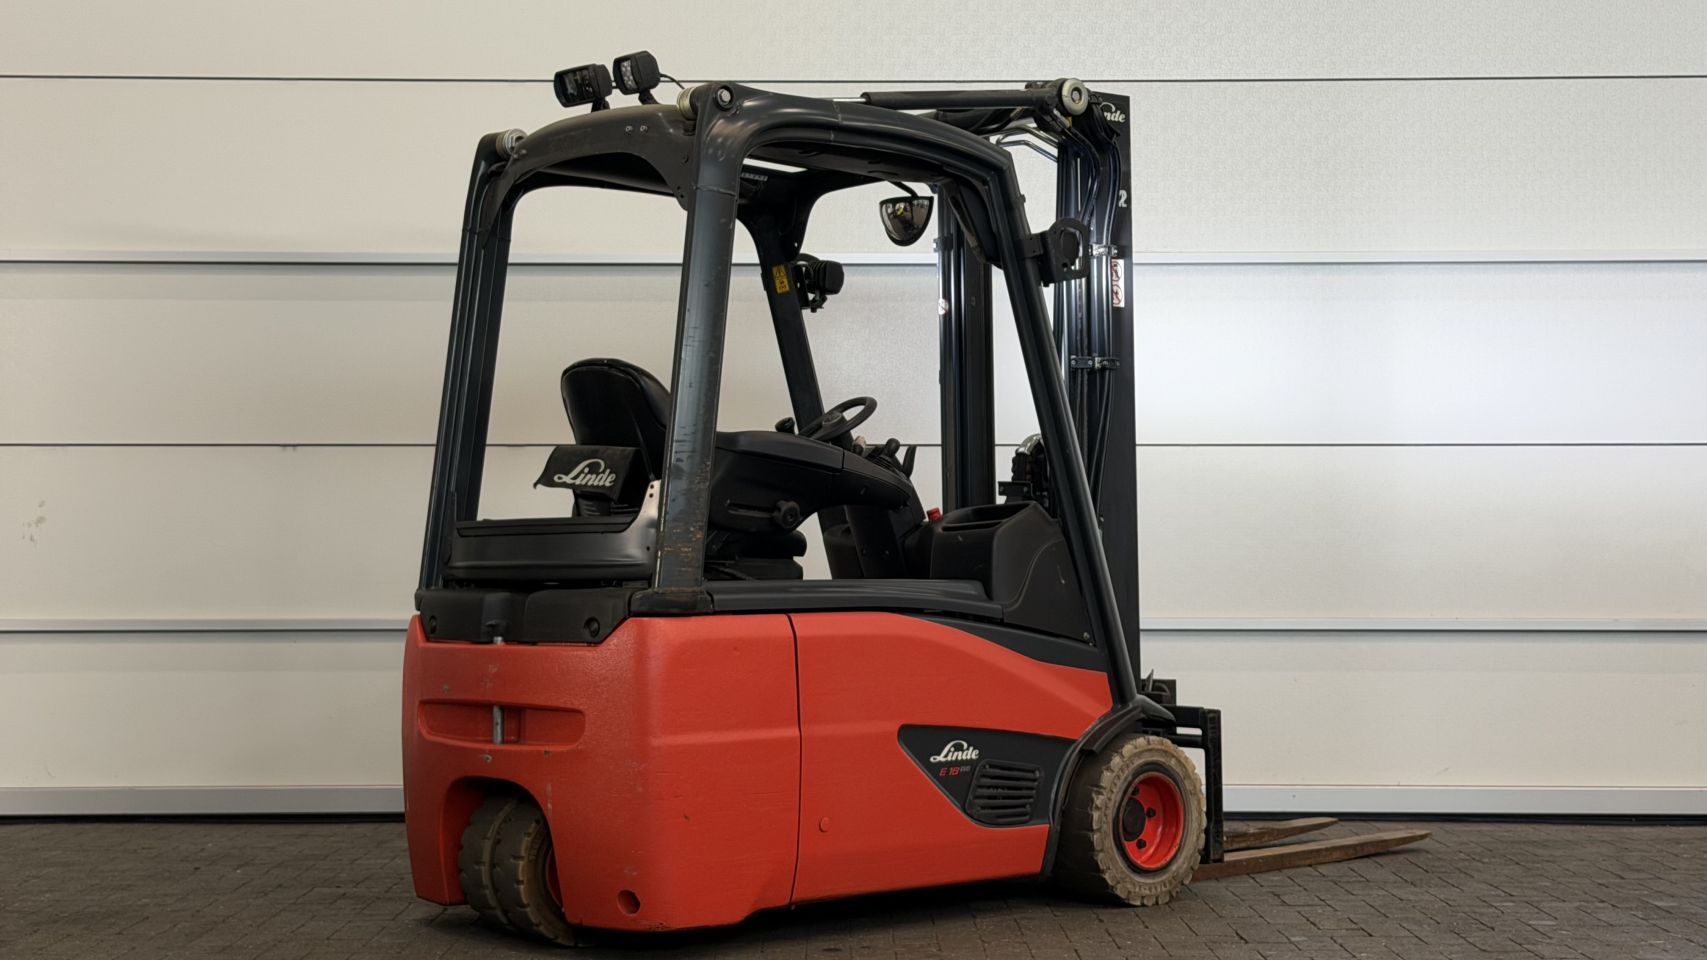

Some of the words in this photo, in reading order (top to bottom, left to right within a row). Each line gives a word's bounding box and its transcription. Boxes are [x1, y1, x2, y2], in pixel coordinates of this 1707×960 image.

[1100, 102, 1126, 123] nde
[553, 458, 616, 487] Linde
[930, 740, 980, 763] Linde
